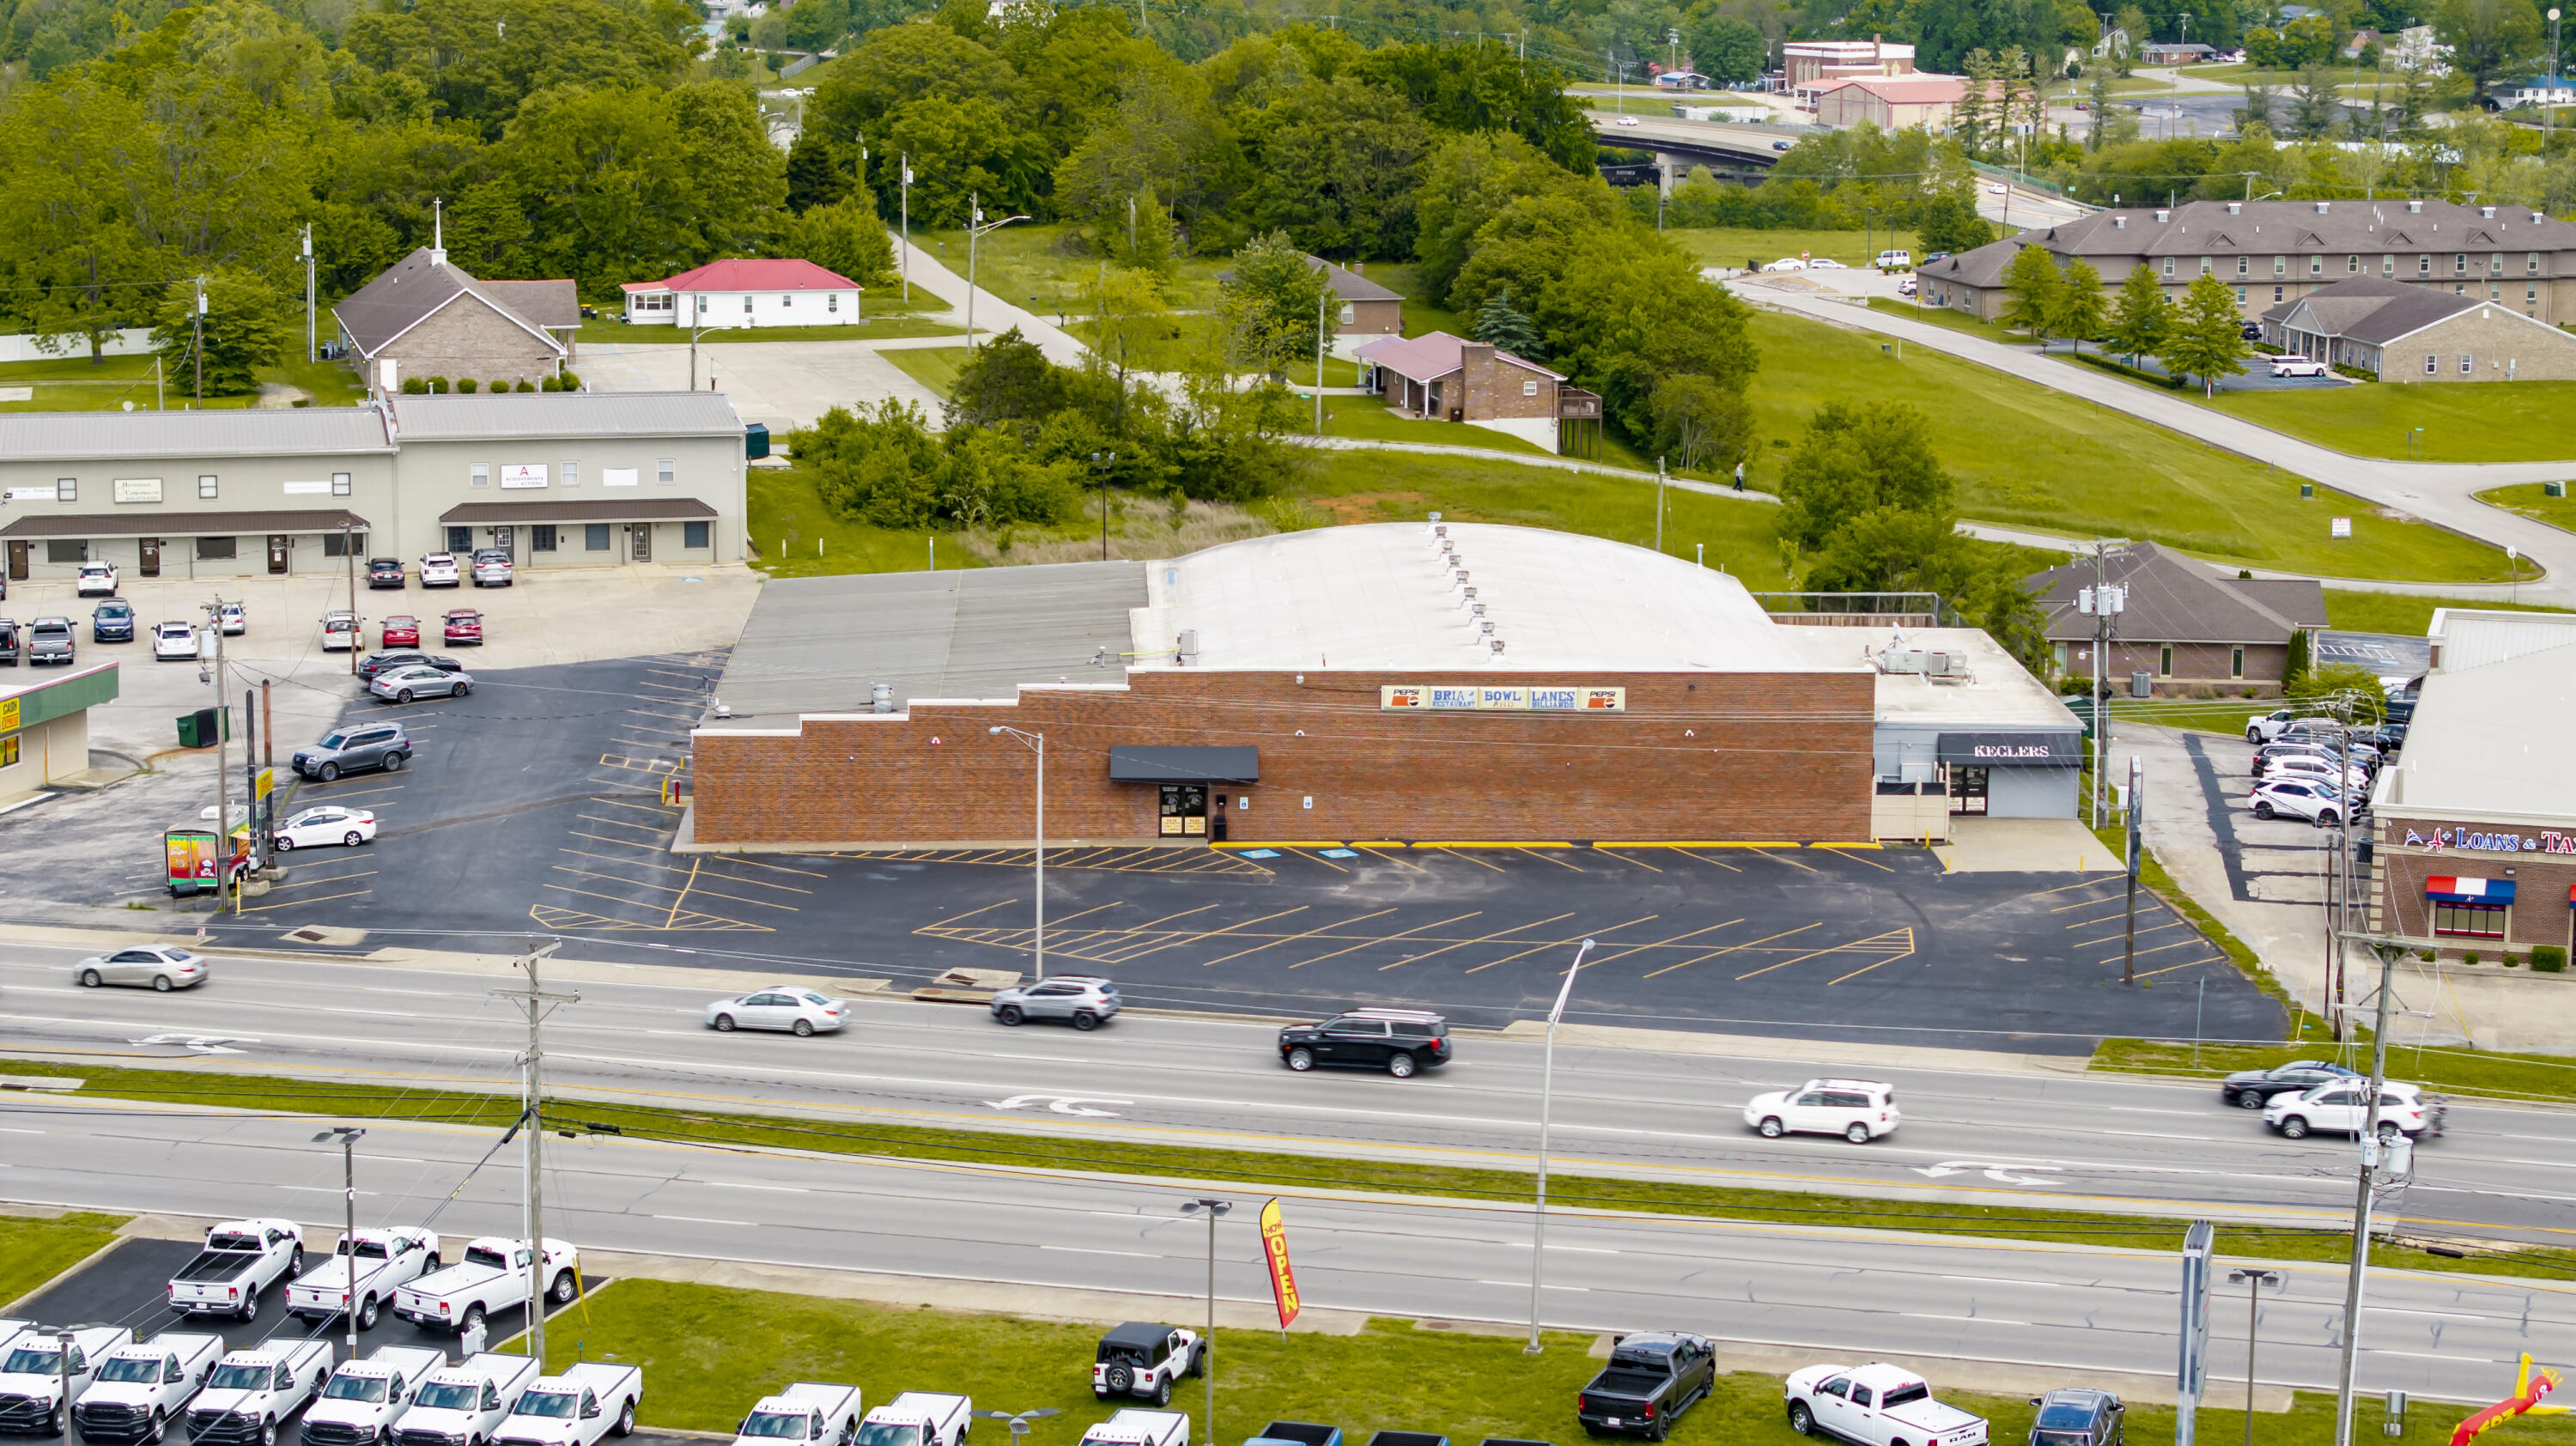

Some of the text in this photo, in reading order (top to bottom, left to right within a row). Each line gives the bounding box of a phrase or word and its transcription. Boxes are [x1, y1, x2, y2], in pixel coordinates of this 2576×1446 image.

[1484, 690, 1522, 702] BOWL
[1532, 690, 1575, 702] LANES
[3, 700, 17, 714] CASH
[2455, 827, 2519, 852] LOANS
[2522, 838, 2537, 850] &
[1270, 1236, 1298, 1314] OPEN
[1949, 1431, 1977, 1443] RAM
